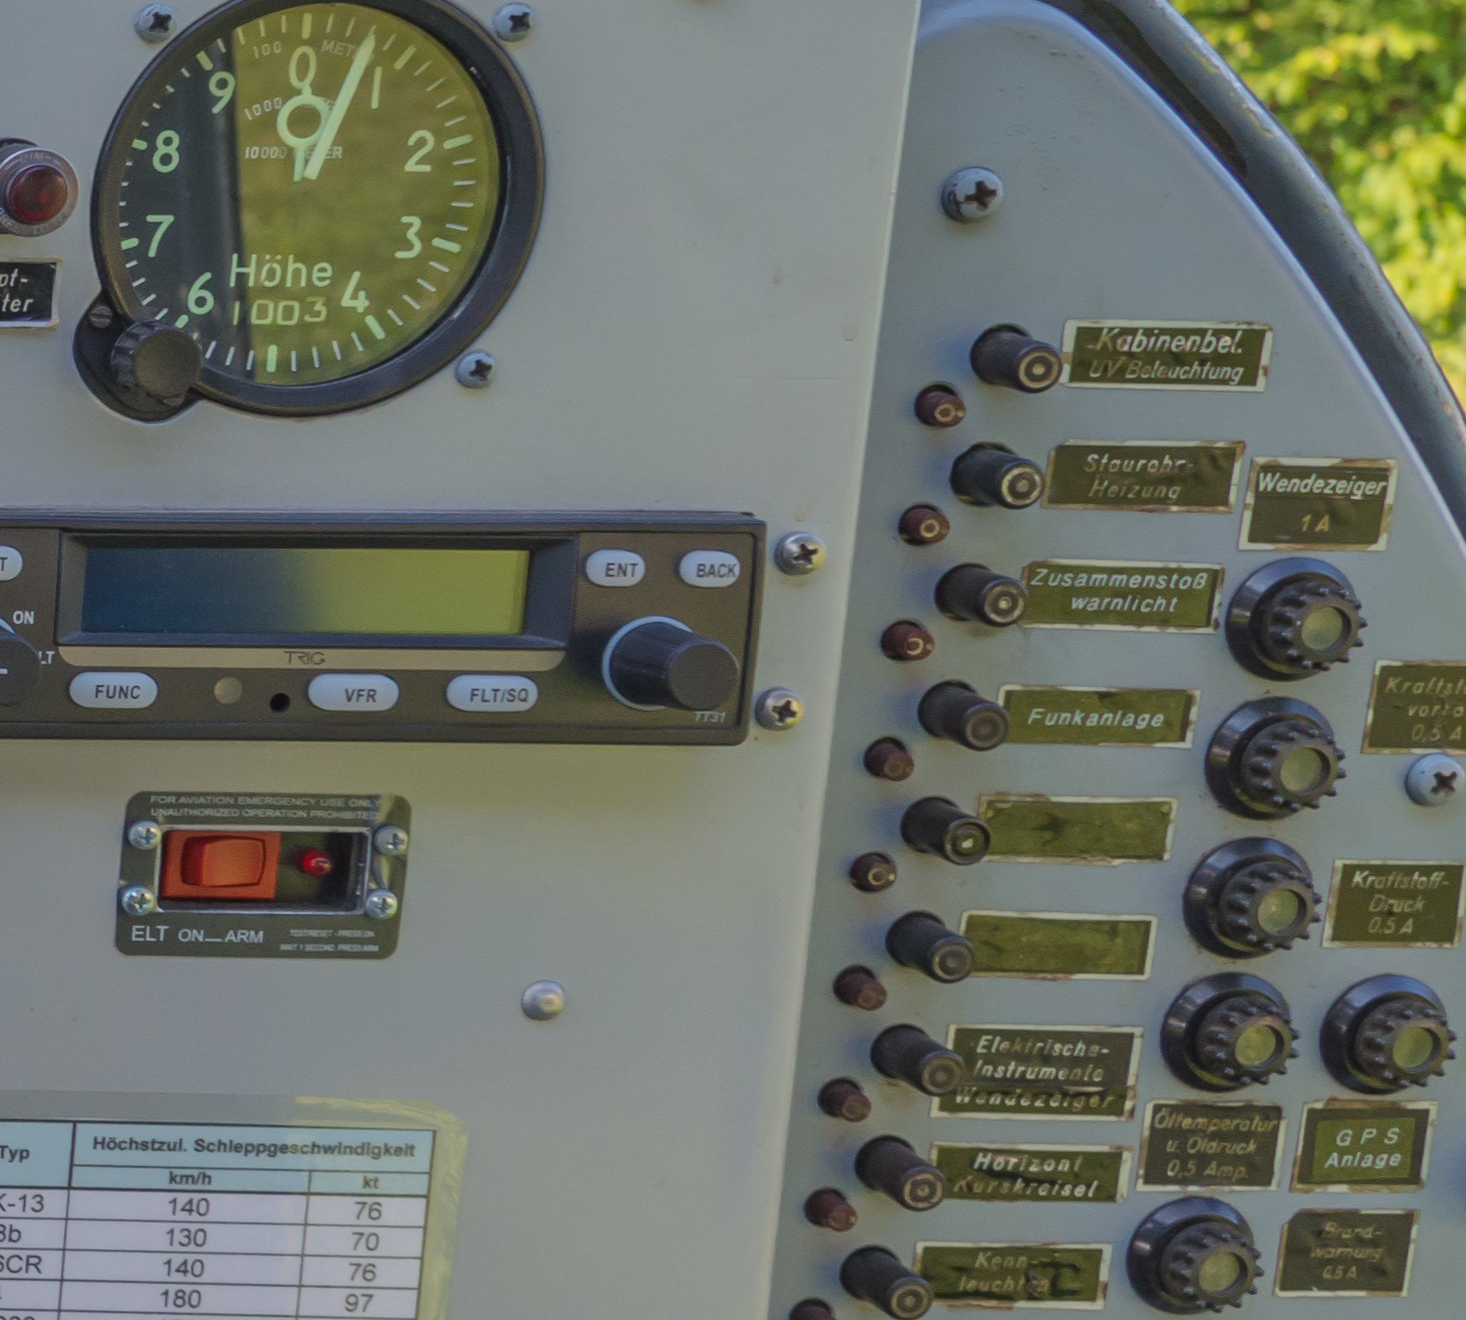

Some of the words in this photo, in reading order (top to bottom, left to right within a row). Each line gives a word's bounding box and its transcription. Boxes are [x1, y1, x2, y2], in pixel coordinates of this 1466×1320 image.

[229, 253, 333, 290] Höhe
[1096, 328, 1243, 356] Kabinenbel.
[1258, 472, 1388, 498] Wendezeiger
[604, 562, 638, 579] ENT
[695, 562, 737, 579] BACK
[1030, 569, 1207, 590] Zusammenstoß
[1070, 593, 1179, 613] warnlicht
[94, 684, 142, 701] FUNC
[344, 687, 378, 704] VFR
[469, 686, 529, 706] FLT/SQ
[1027, 708, 1165, 730] Funkanlage
[132, 925, 169, 941] ELT
[93, 1136, 188, 1153] Höchstzul.
[194, 1139, 416, 1159] Schleppgeschwindigkeit
[168, 1197, 210, 1217] 140
[160, 1289, 202, 1309] 180
